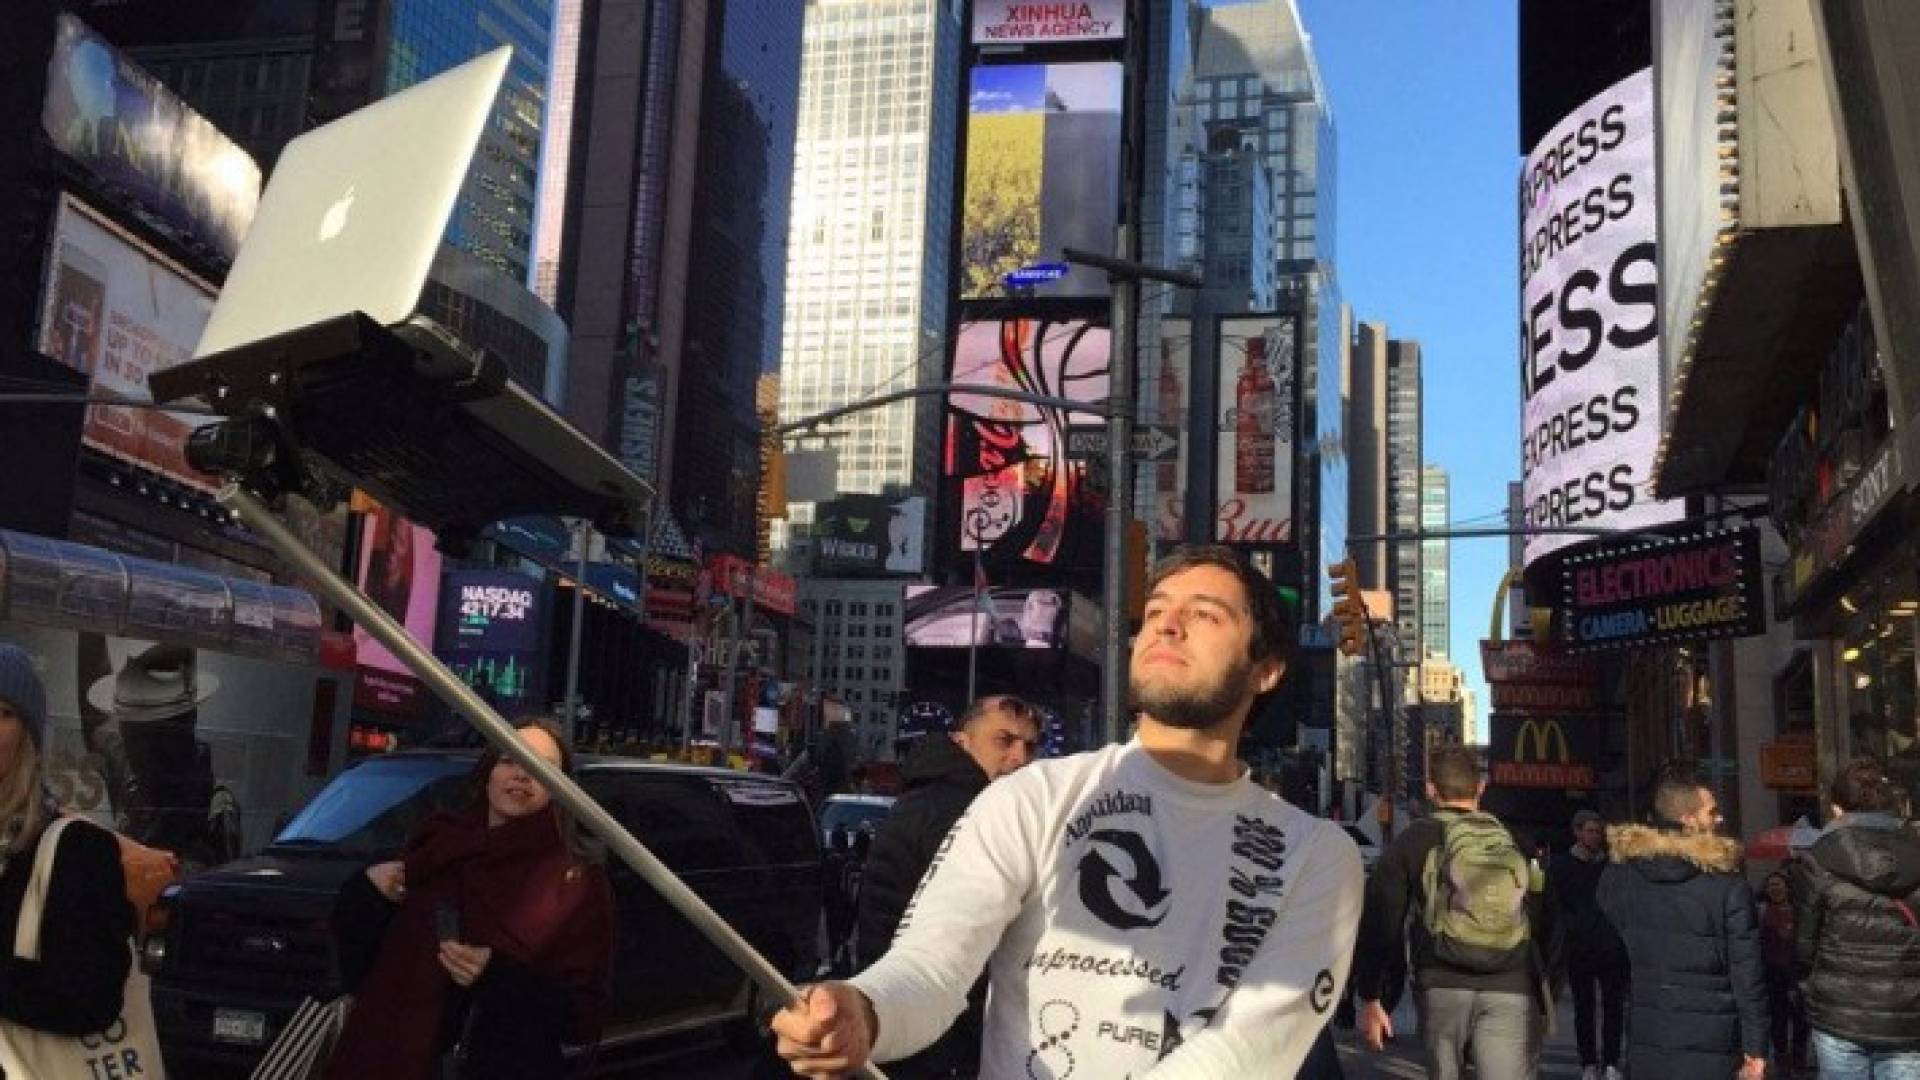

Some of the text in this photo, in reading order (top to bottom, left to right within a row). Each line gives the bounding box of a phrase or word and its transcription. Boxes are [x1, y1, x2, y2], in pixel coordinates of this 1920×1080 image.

[1006, 3, 1092, 22] XINHUA
[984, 20, 1112, 39] NEWS AGENCY
[1576, 545, 1737, 606] ELECTRONICS
[461, 585, 532, 608] NASDAQ
[1579, 596, 1741, 640] CAMERA LUGGAGE
